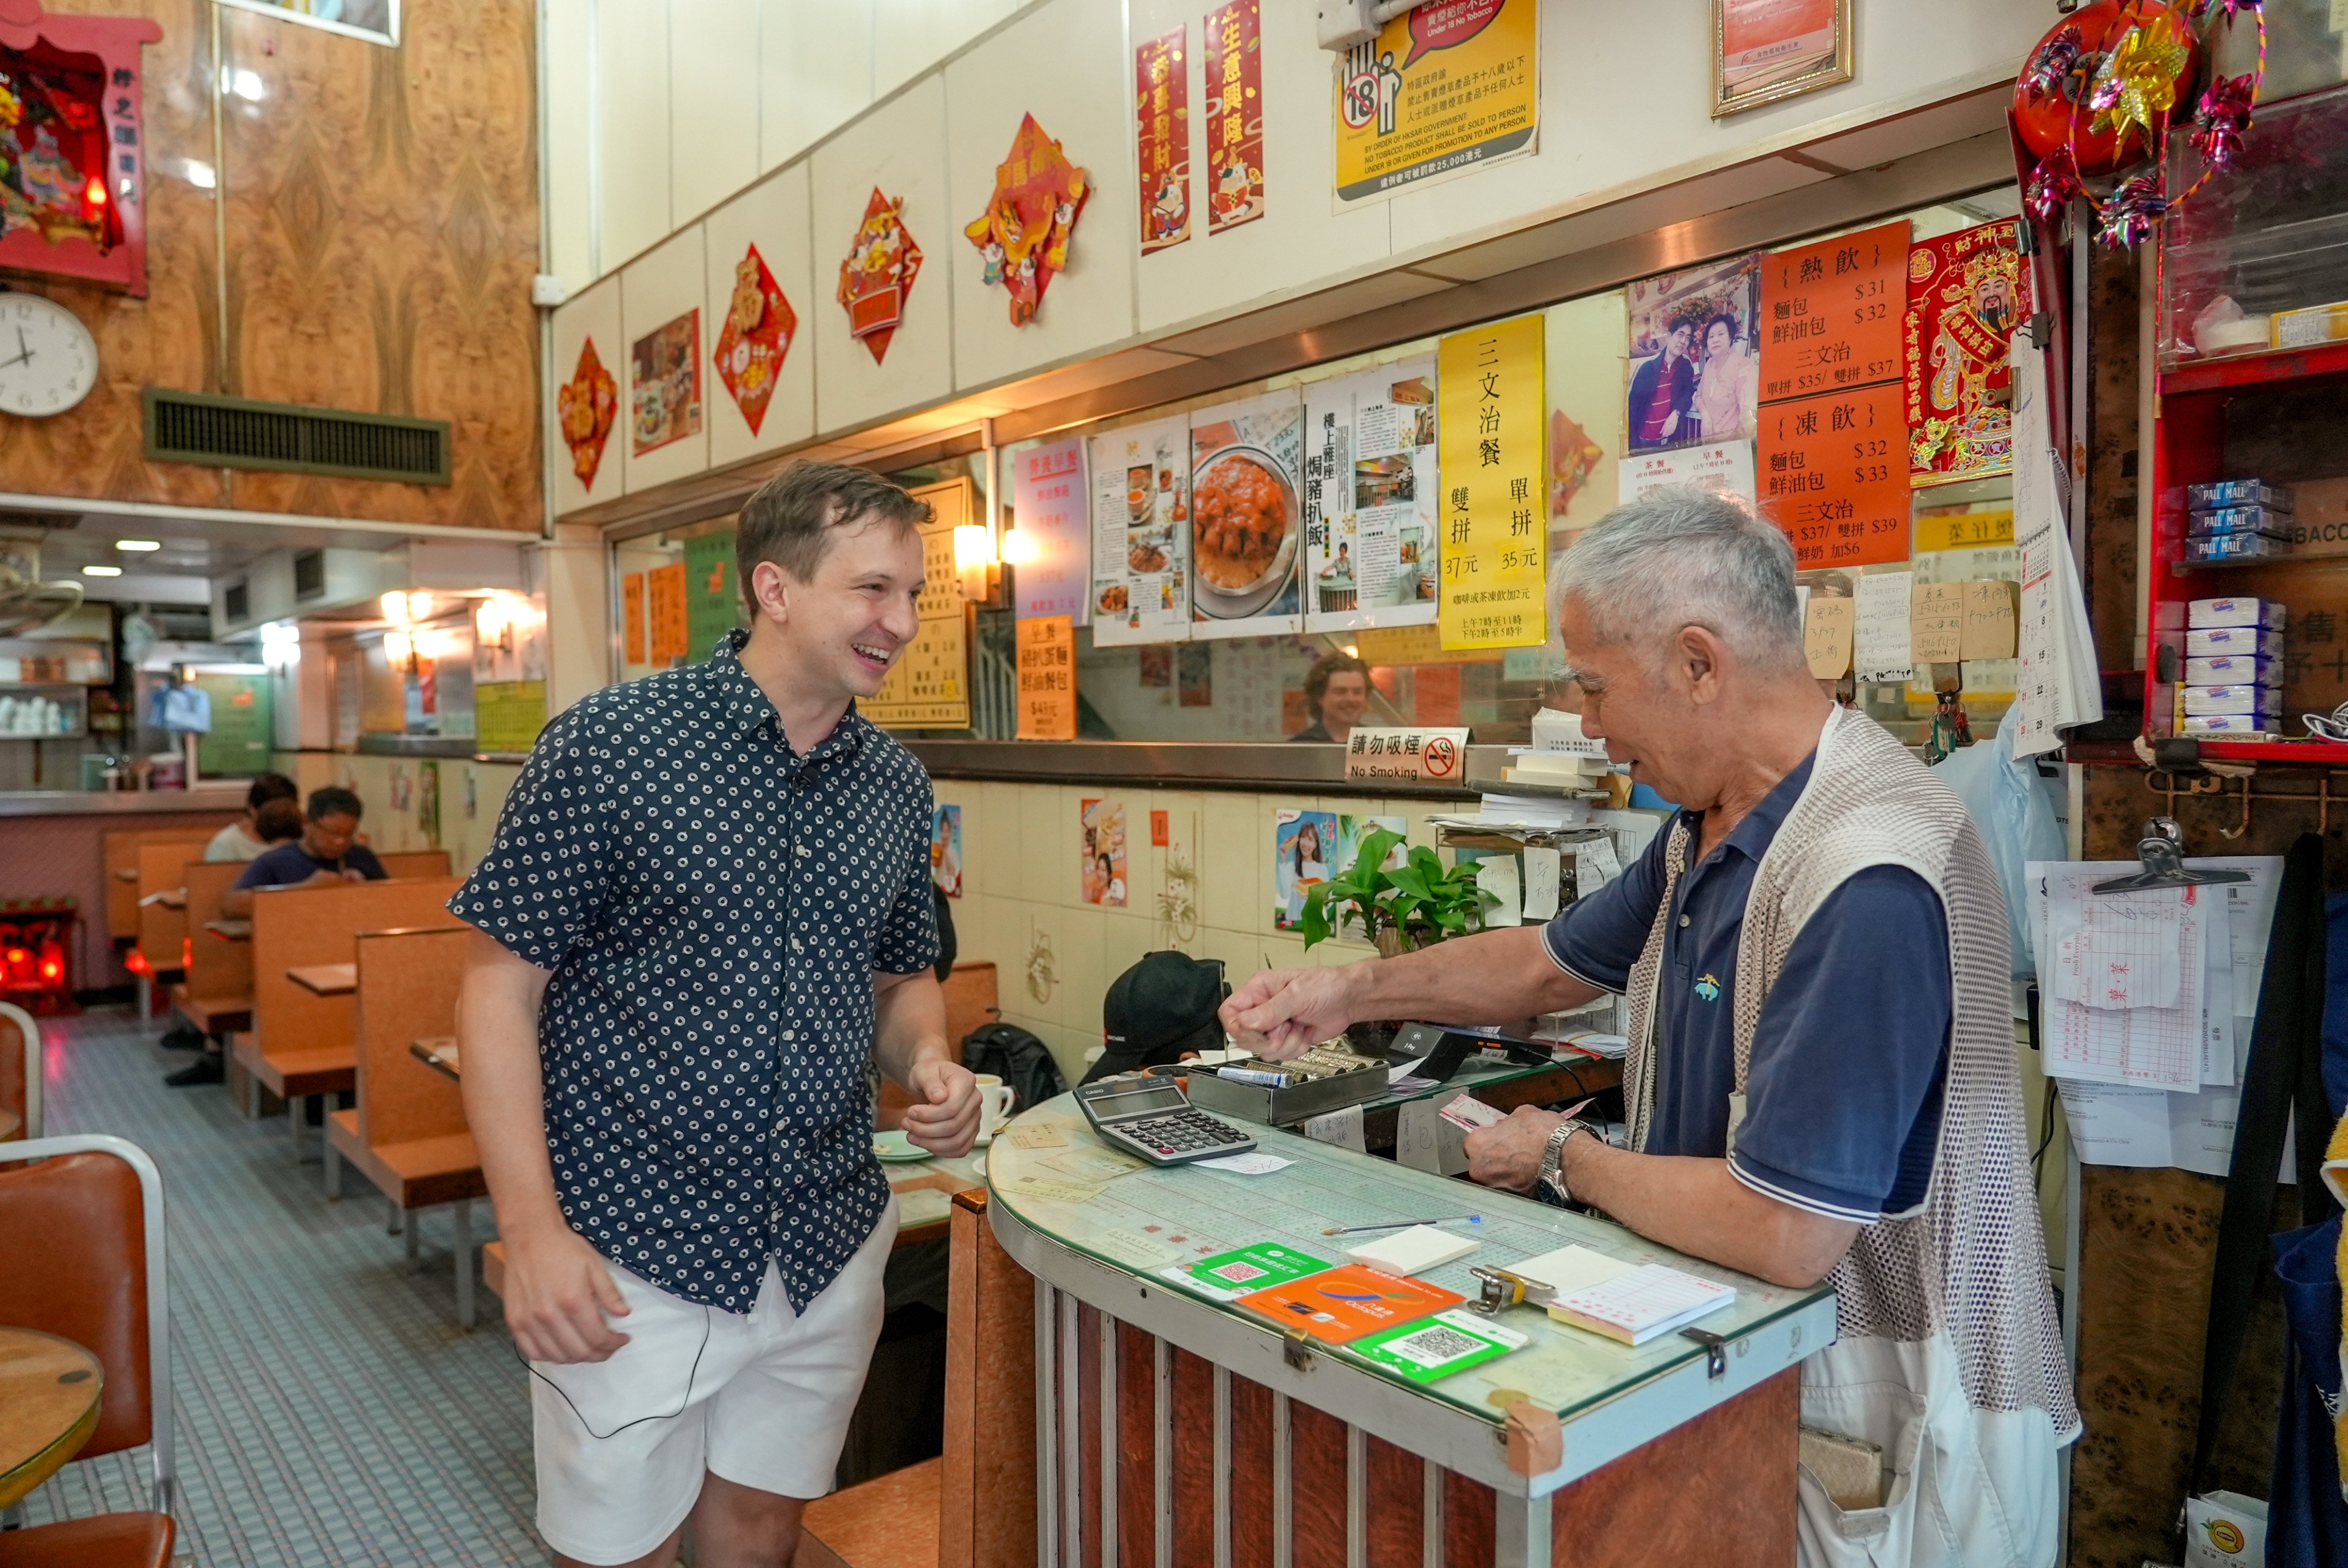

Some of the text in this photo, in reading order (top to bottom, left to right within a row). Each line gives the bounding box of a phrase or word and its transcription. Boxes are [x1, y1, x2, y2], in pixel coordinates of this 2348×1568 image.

[1427, 7, 1493, 37] Under 18 No Tobacco
[1221, 22, 1244, 147] 生意興隆
[1347, 80, 1375, 121] 18
[1365, 103, 1526, 165] NO TOBACCO PRODUCT SHALL BE SOLD TO PERSON
[1365, 145, 1373, 154] BY
[1373, 138, 1392, 151] ORDER
[1393, 135, 1402, 144] OF
[1402, 127, 1423, 142] HKSAR
[1365, 115, 1526, 175] UNDER 18 OR GIVEN FOR PROMOTION TO ANY PERSON
[1380, 148, 1482, 189] 違例者可被罰款25,000港元
[1855, 279, 1885, 300] $31
[1773, 298, 1808, 322] 麵包
[1855, 303, 1886, 324] $32
[1772, 316, 1826, 345] 鮮油包
[1796, 341, 1850, 369] 三文治
[1767, 379, 1791, 396] 單拼
[1834, 366, 1861, 384] 雙拼
[1868, 359, 1893, 377] $37
[1478, 339, 1501, 468] 三文治餐
[1323, 412, 1335, 480] 樓上雅座
[1854, 440, 1887, 459] $32
[1769, 450, 1806, 473] 麵包
[1769, 472, 1826, 496] 鮮油包
[1855, 466, 1888, 483] $33
[1307, 455, 1323, 547] 焗豬扒飯
[2203, 487, 2245, 501] PALL MALL
[1452, 486, 1471, 545] 雙拼
[1509, 477, 1532, 536] 單拼
[1796, 499, 1854, 523] 三文治
[1838, 522, 1865, 538] 雙拼
[1872, 518, 1897, 533] $39
[2204, 514, 2247, 527] PALL MALL
[1502, 548, 1537, 570] 35元
[1798, 542, 1860, 561] 鮮奶 加$6
[2199, 541, 2241, 554] PALL MALL
[1445, 555, 1478, 579] 37元
[1453, 588, 1530, 605] 咖啡或茶凍飲加2元
[1462, 615, 1522, 629] 上午7時至11時
[1462, 627, 1523, 640] 下午2時至5時半
[2038, 650, 2045, 660] 15
[2037, 685, 2044, 695] 22
[2036, 720, 2043, 730] 29
[1351, 734, 1421, 756] 請勿吸煙
[1351, 766, 1417, 780] No Smoking
[2073, 931, 2081, 956] Everyday
[1345, 1300, 1386, 1319] Octopus
